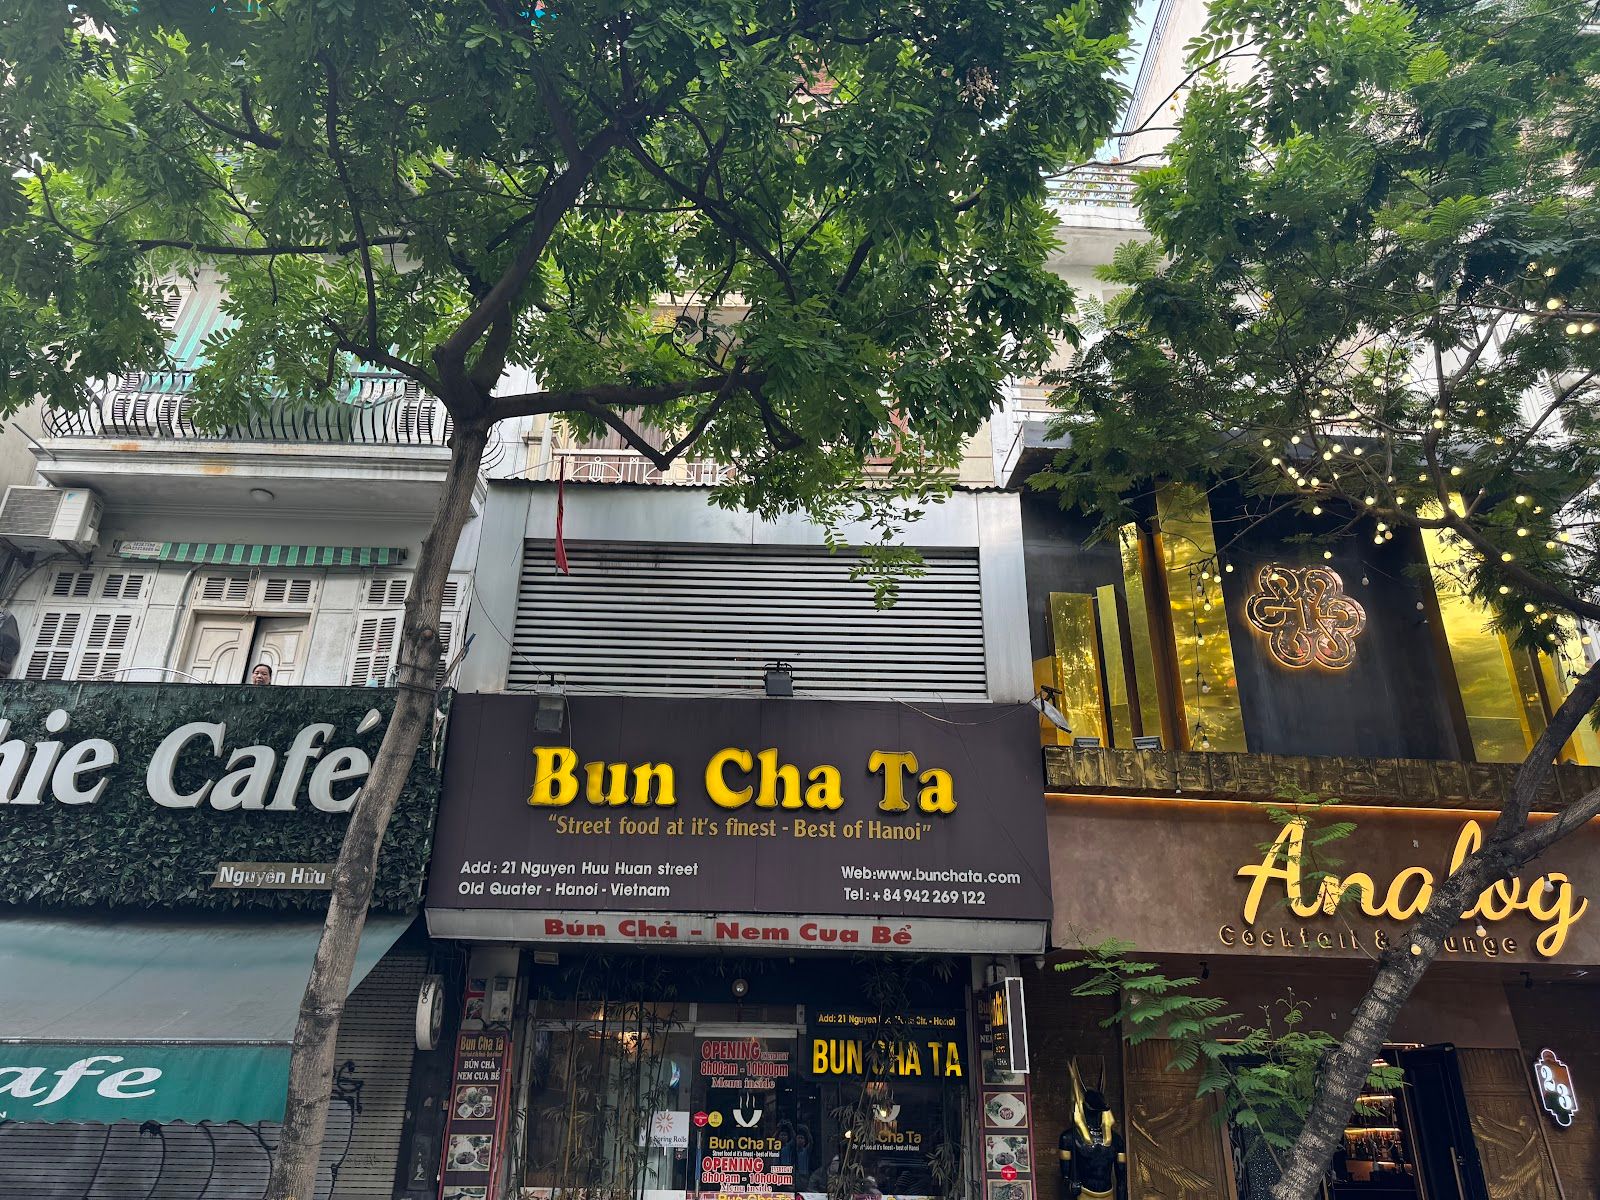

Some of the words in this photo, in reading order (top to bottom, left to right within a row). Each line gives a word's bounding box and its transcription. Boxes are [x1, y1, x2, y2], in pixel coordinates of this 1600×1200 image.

[146, 708, 382, 813] Café
[527, 746, 677, 806] Bun
[705, 747, 844, 809] Cha
[868, 750, 957, 813] Ta
[619, 816, 660, 835] food
[666, 818, 684, 835] at
[692, 817, 718, 836] it's
[726, 818, 776, 837] finest
[794, 819, 836, 838] Best
[843, 820, 863, 838] of
[501, 861, 516, 874] 21
[521, 862, 576, 877] Nguyen
[581, 862, 609, 875] Huu
[615, 862, 651, 875] Huan
[658, 862, 699, 876] street
[458, 882, 485, 895] Old
[489, 882, 542, 896] Quater
[555, 882, 598, 896] Hanoi
[611, 883, 670, 896] Vietnam
[904, 889, 930, 903] 942
[933, 890, 959, 903] 269
[962, 891, 986, 905] 122
[544, 919, 606, 937] Bún
[618, 919, 678, 939] Chả
[716, 922, 790, 941] Nem
[799, 923, 859, 943] Cua
[872, 924, 913, 945] Bể
[1219, 924, 1359, 950] Cocktail
[1443, 935, 1518, 957] unge
[837, 1014, 846, 1023] 21
[848, 1015, 877, 1025] Nguyen
[461, 1036, 477, 1050] Bun
[478, 1036, 494, 1050] Cha
[702, 1040, 760, 1060] OPENING
[813, 1039, 863, 1074] BUN
[927, 1041, 962, 1077] TA
[457, 1071, 473, 1081] NEM
[474, 1071, 489, 1081] CUA
[701, 1060, 738, 1076] 8h00am
[746, 1061, 789, 1078] 10h00pm
[711, 1077, 742, 1089] Menu
[744, 1077, 776, 1090] inside
[709, 1137, 735, 1150] Bun
[738, 1137, 764, 1150] Cha
[766, 1138, 782, 1151] Ta
[906, 1131, 922, 1144] Ta
[702, 1156, 763, 1172] OPENING
[702, 1172, 740, 1183] 8h00am
[749, 1172, 793, 1186] 10h00pm
[720, 1183, 745, 1193] Menu
[746, 1183, 773, 1193] inside
